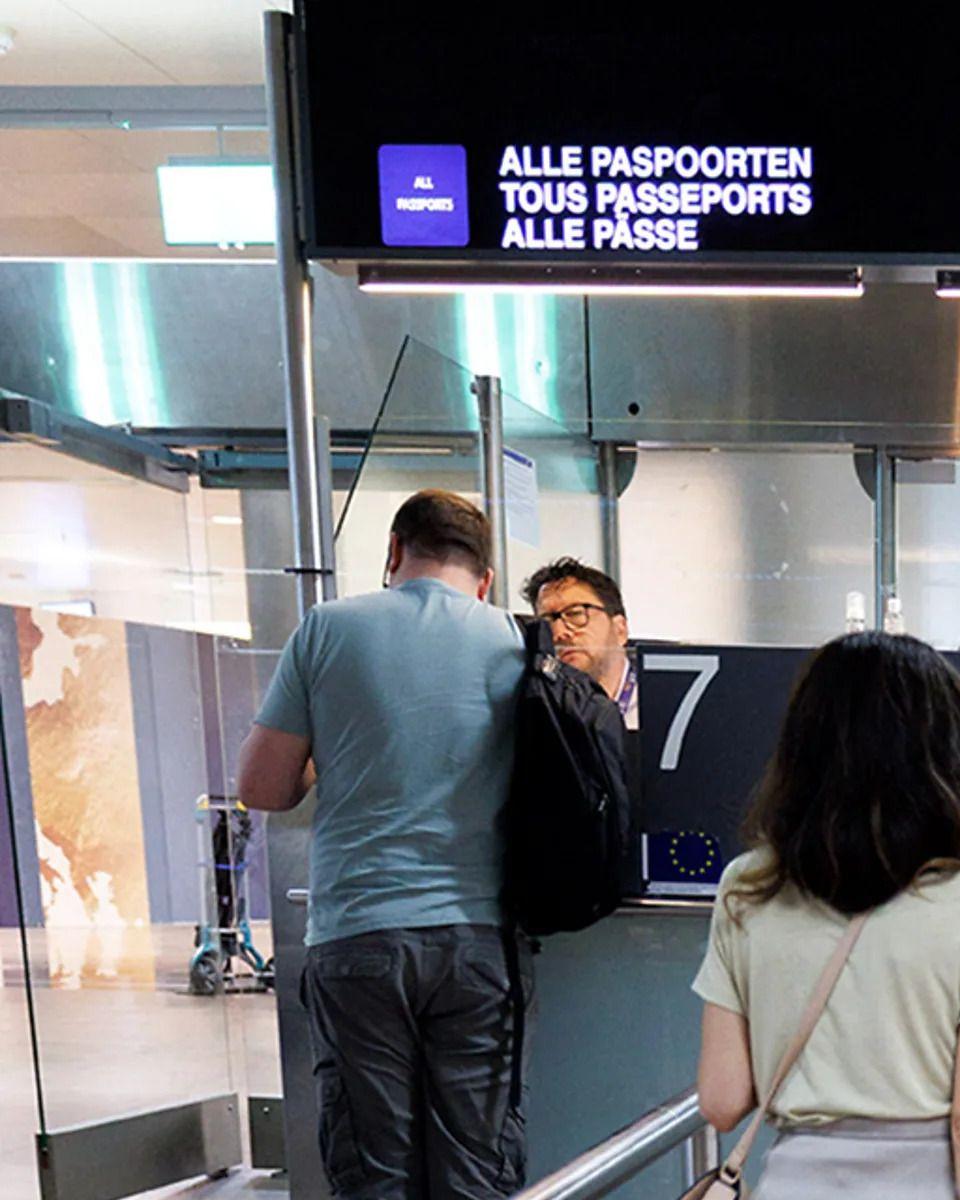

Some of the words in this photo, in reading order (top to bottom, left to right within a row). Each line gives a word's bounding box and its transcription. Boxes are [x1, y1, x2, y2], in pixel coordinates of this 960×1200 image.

[498, 146, 584, 177] ALLE
[592, 146, 812, 179] PASPOORTEN
[413, 176, 434, 190] ALL
[498, 181, 589, 214] TOUS
[596, 181, 812, 215] PASSEPORTS
[501, 218, 586, 250] ALLE
[643, 655, 720, 771] 7
